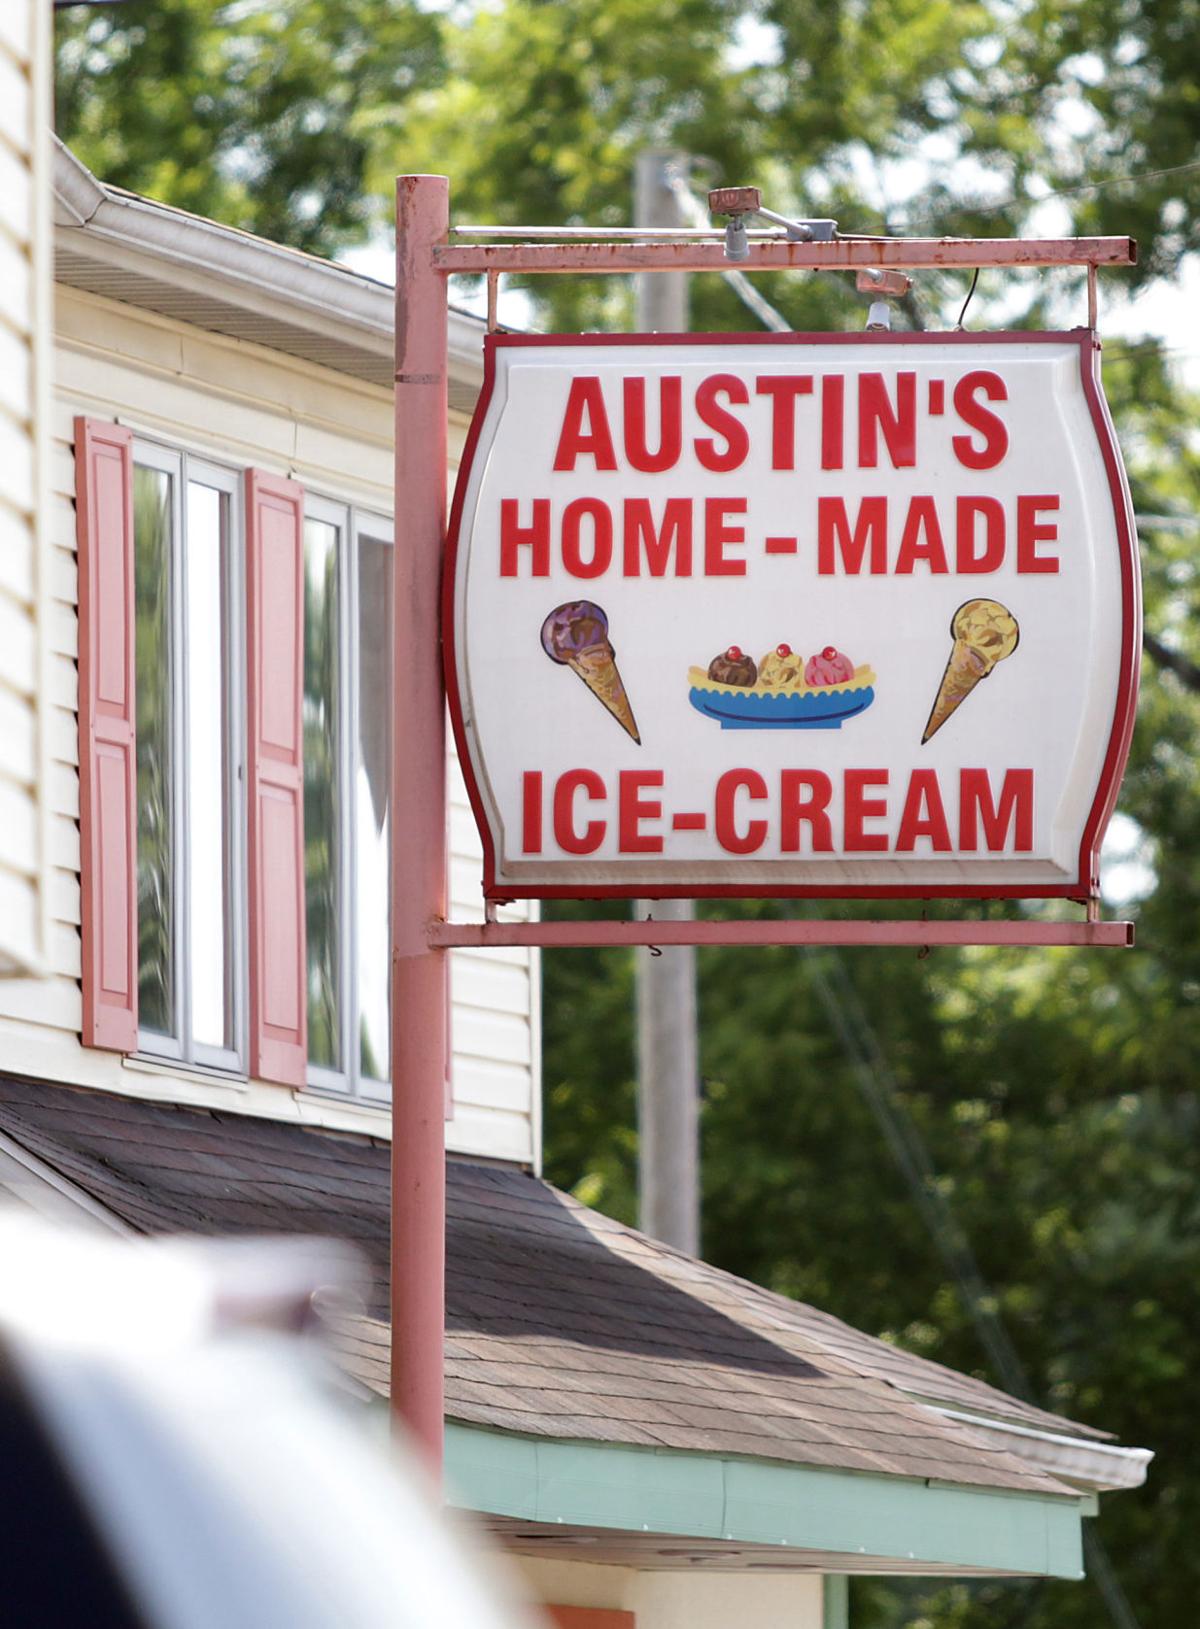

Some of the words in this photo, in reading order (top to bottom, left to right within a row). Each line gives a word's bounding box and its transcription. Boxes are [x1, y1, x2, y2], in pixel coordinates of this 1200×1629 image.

[553, 371, 1008, 473] AUSTIN'S
[500, 495, 1060, 579] HOME-MADE
[523, 768, 1033, 855] ICE-CREAM
